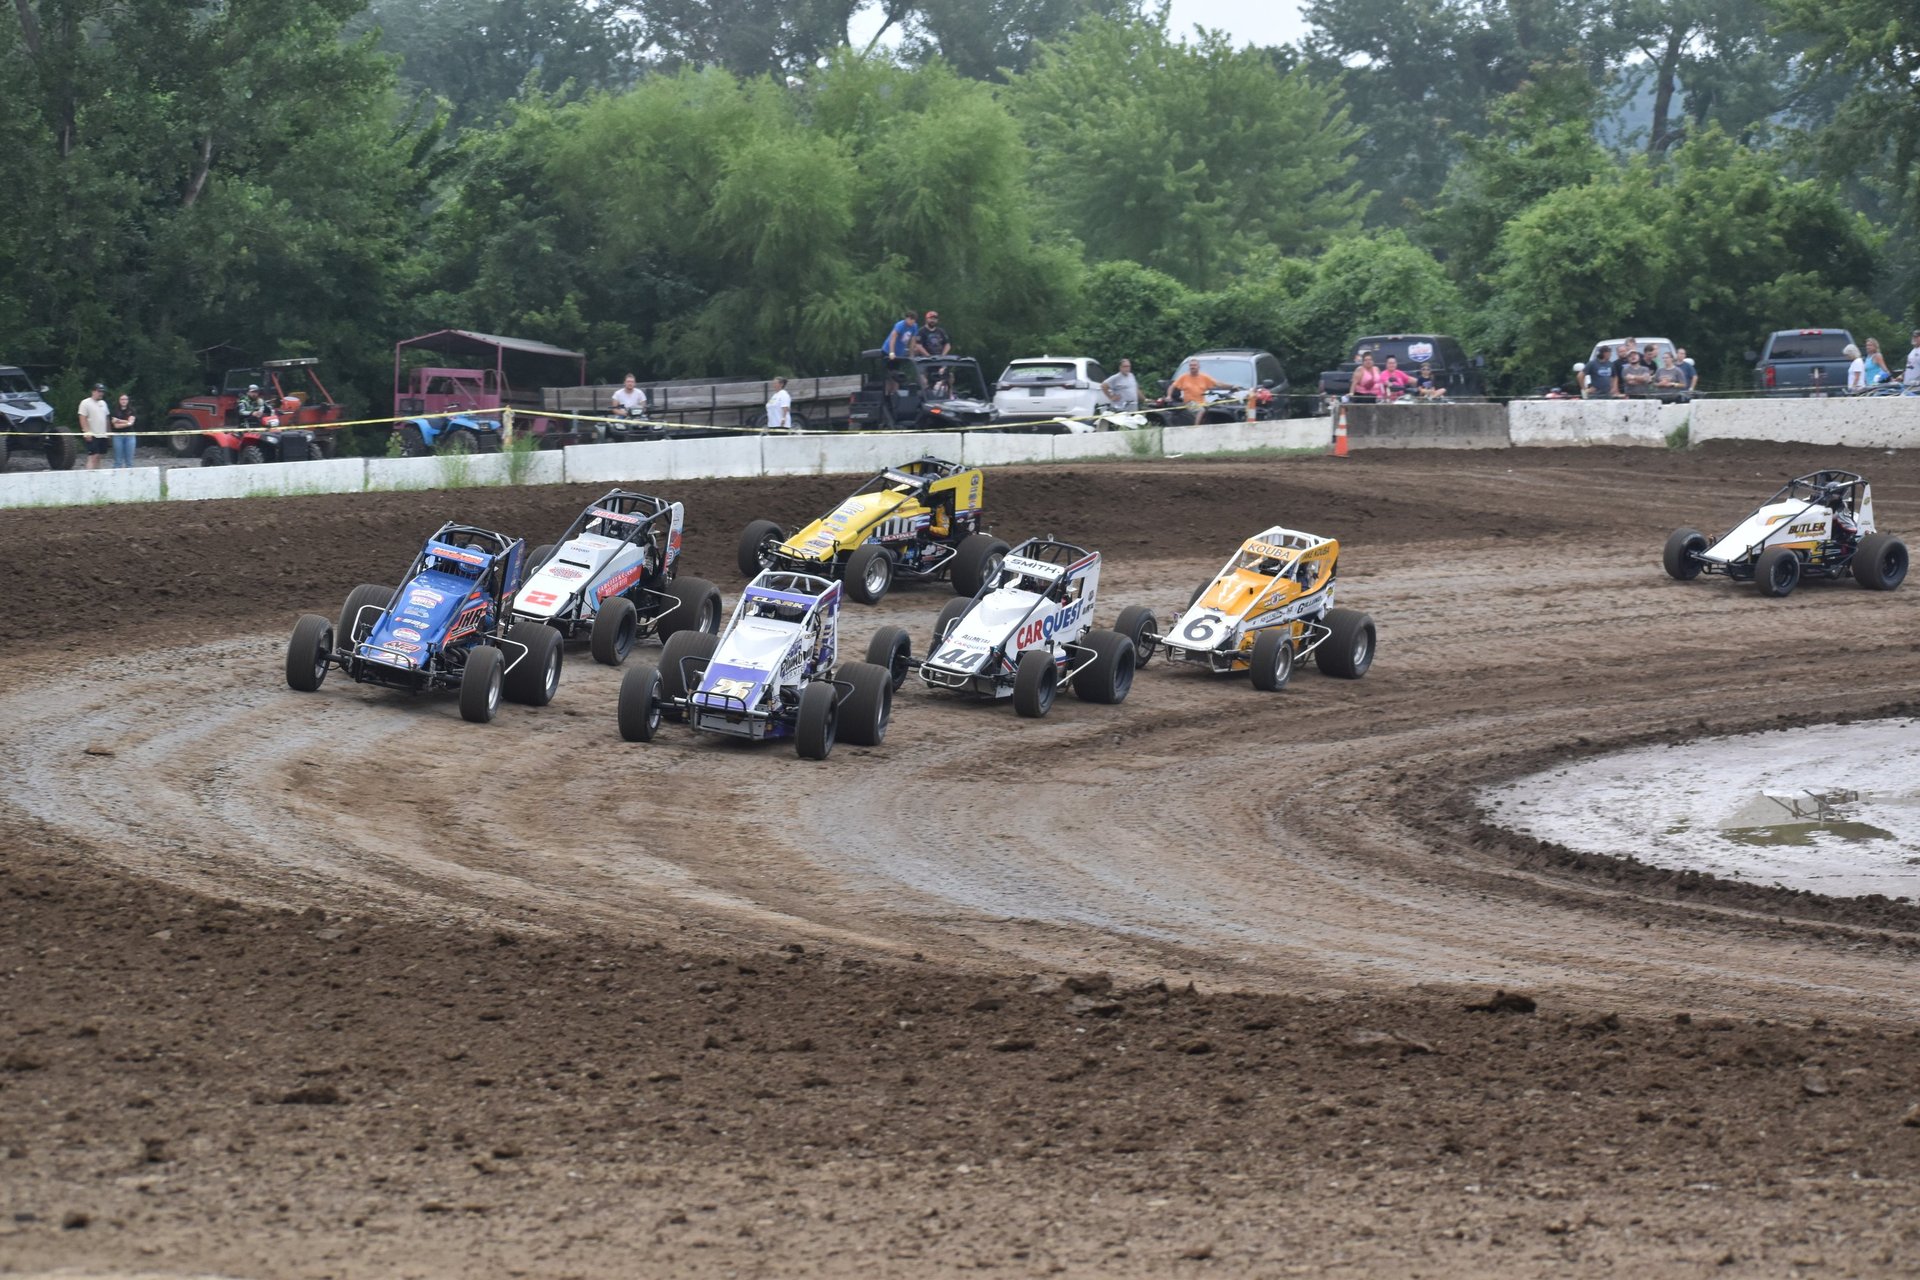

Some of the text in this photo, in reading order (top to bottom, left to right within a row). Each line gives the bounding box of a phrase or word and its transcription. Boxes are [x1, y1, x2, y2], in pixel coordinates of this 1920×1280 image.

[591, 509, 639, 524] HOWARD
[1788, 522, 1826, 534] BUTLER
[1248, 543, 1291, 559] KOUBA
[1010, 558, 1058, 574] SMITH
[524, 590, 558, 607] 2
[752, 596, 805, 609] CLARK
[452, 607, 483, 632] JHR
[1016, 600, 1083, 650] CARQUEST
[1184, 614, 1222, 641] 6
[937, 649, 985, 669] 44
